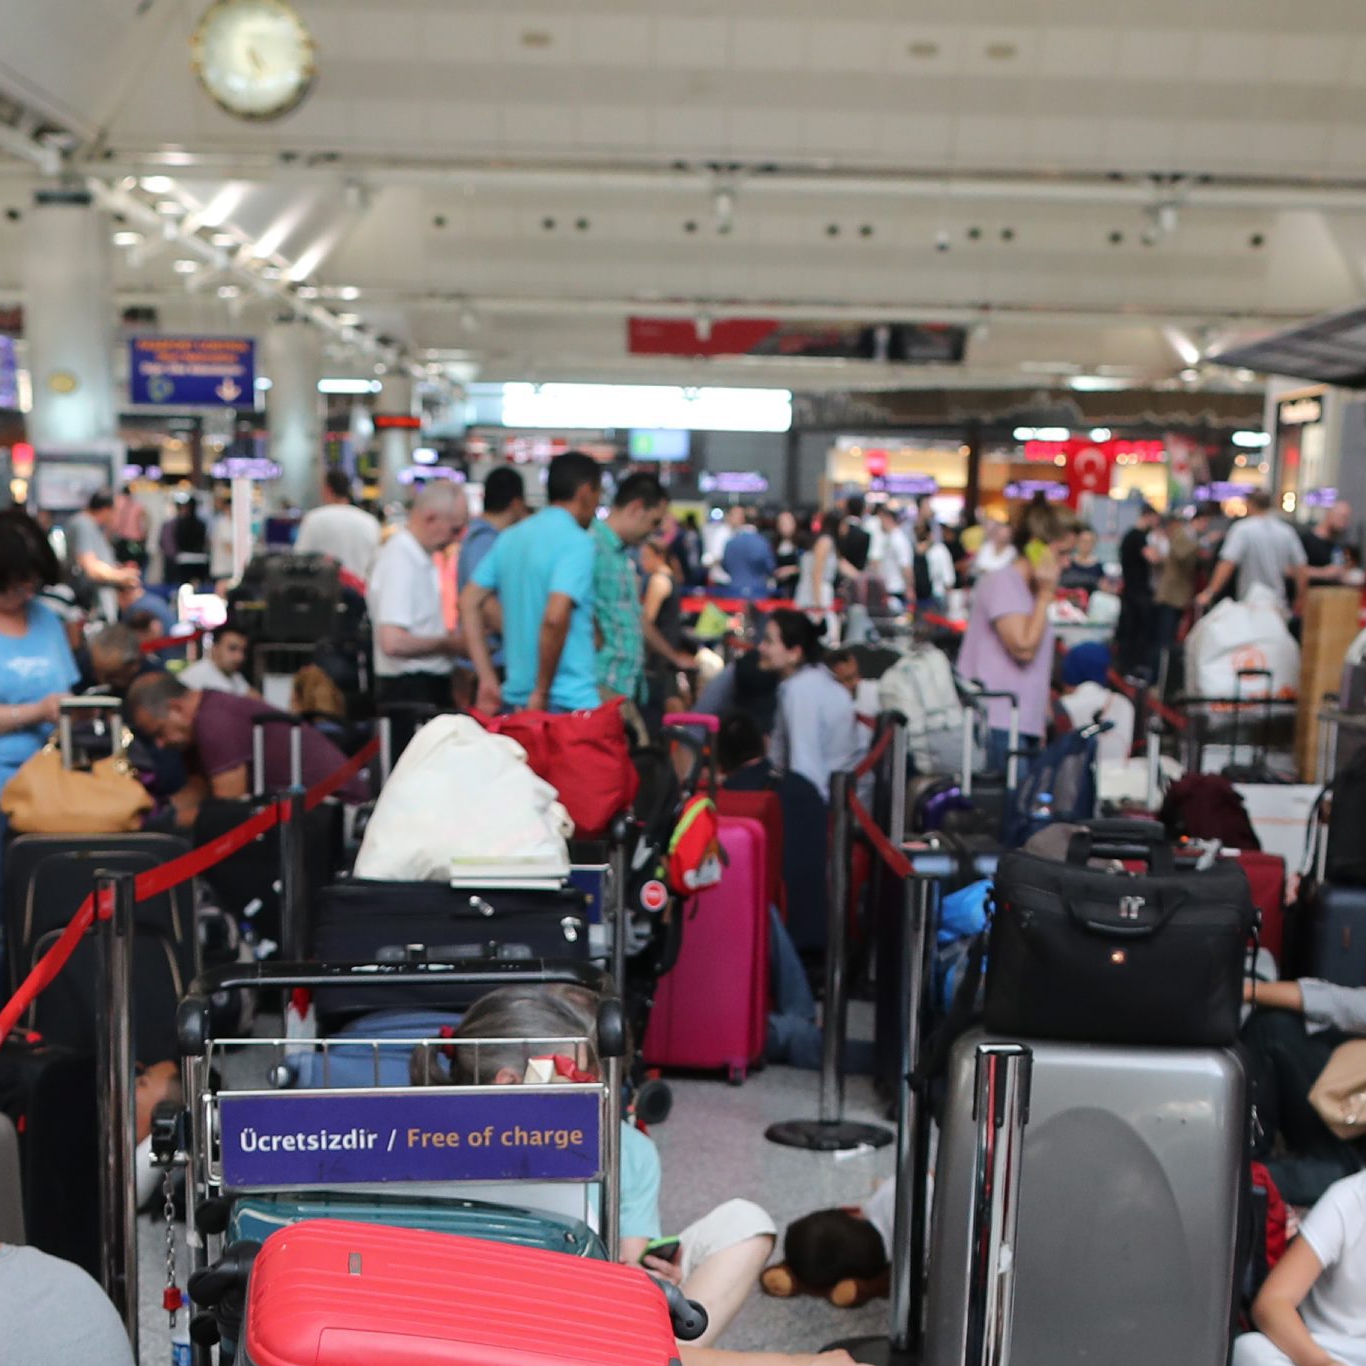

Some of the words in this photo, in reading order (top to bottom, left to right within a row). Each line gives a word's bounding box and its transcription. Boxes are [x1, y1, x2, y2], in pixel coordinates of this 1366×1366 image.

[240, 1127, 378, 1153] Ücretsizdir
[387, 1128, 397, 1152] /
[407, 1128, 460, 1149] Free
[468, 1126, 493, 1148] of
[501, 1125, 584, 1150] charge
